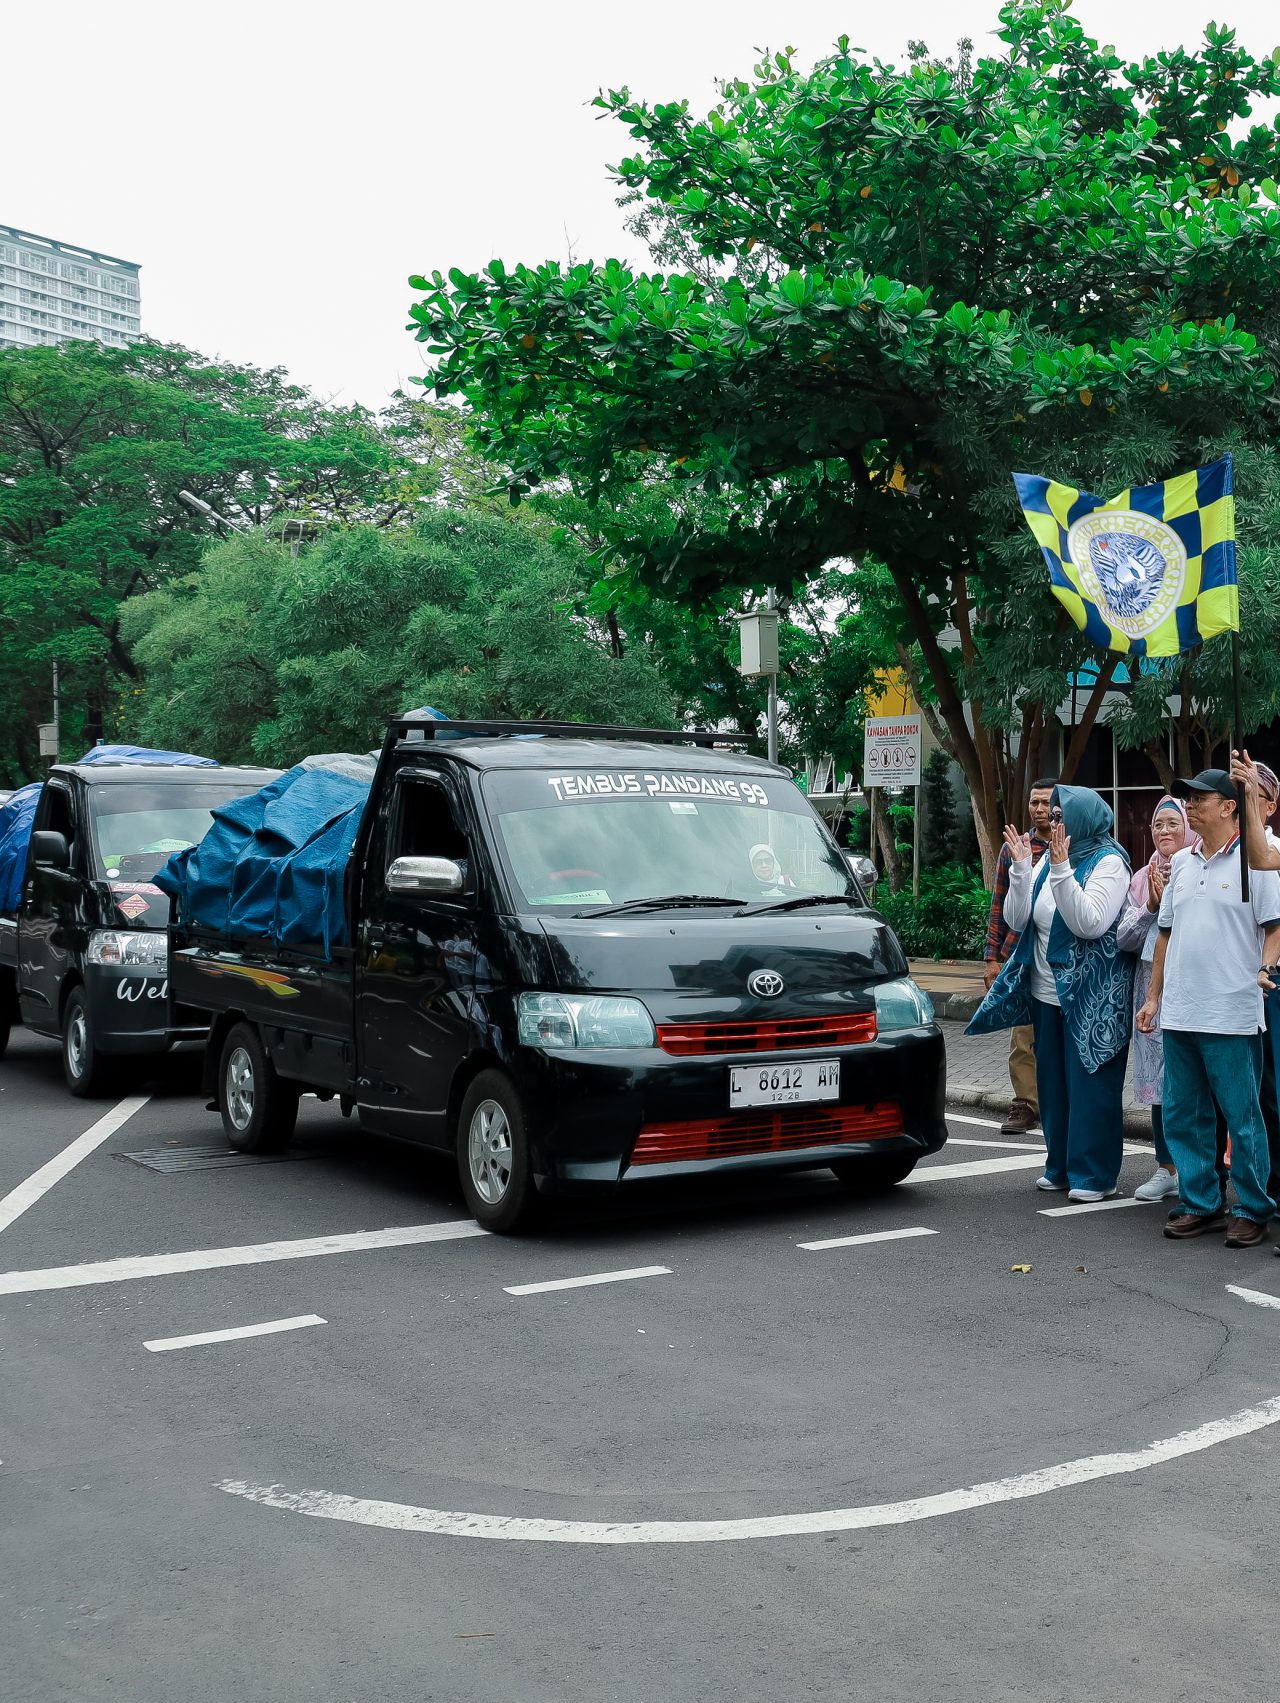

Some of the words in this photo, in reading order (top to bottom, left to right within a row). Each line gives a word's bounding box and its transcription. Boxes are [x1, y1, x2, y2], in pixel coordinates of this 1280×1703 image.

[548, 774, 641, 800] TEMBUS
[643, 775, 742, 801] PANDANG
[740, 782, 769, 806] 99
[731, 1072, 742, 1093] L
[759, 1066, 803, 1091] 8612
[818, 1064, 839, 1086] AM
